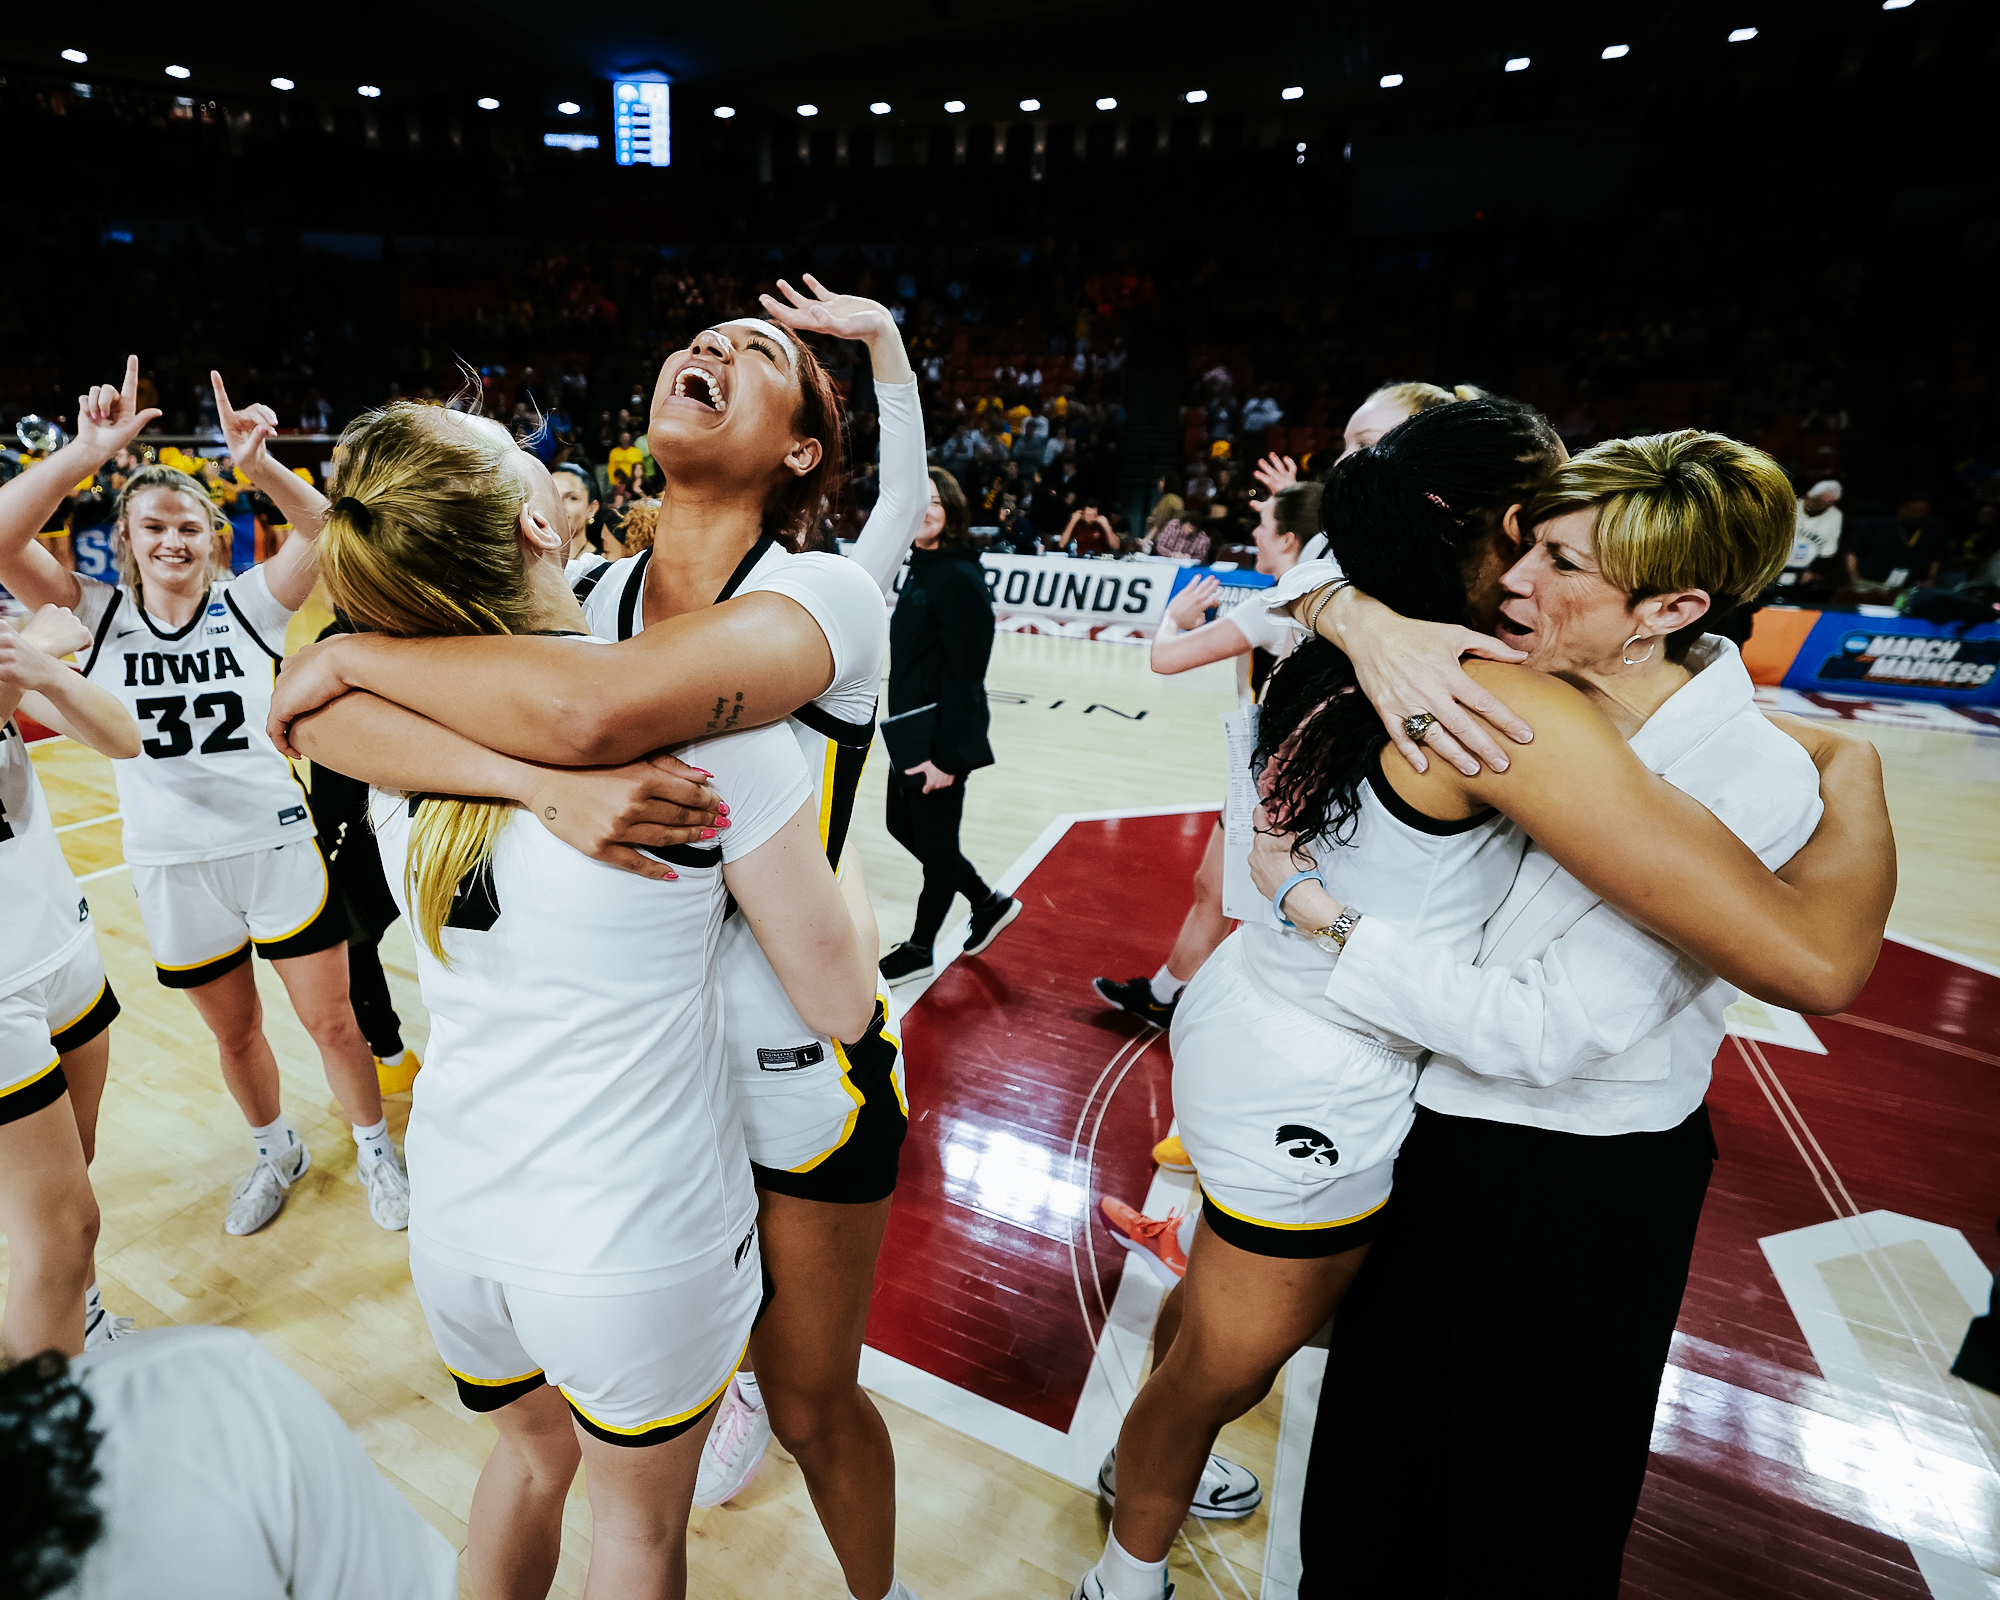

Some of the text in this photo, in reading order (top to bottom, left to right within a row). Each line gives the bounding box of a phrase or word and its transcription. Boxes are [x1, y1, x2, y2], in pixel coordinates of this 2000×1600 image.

[984, 568, 1153, 614] ROUNDS
[1866, 636, 1961, 660] MARCH
[123, 646, 245, 687] IOWA
[1868, 656, 1996, 684] MADNESS
[135, 690, 250, 759] 32
[804, 1053, 813, 1061] L
